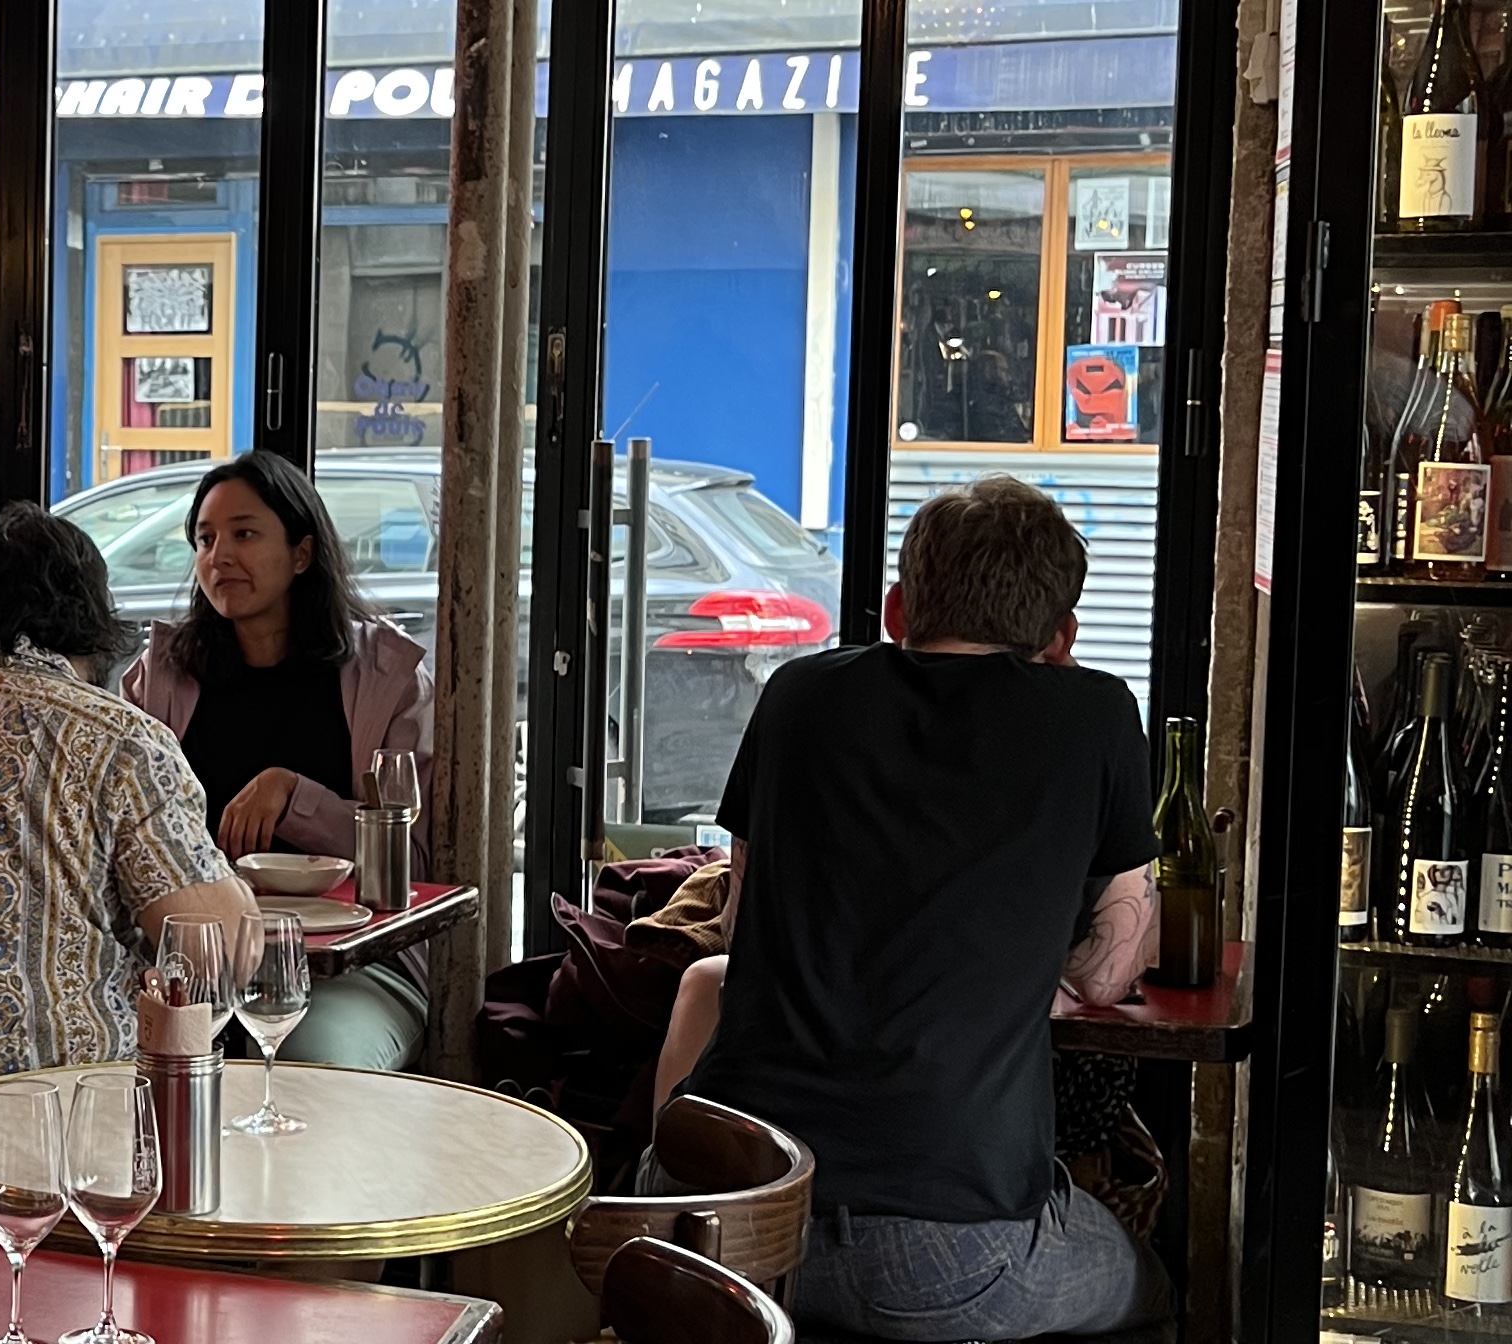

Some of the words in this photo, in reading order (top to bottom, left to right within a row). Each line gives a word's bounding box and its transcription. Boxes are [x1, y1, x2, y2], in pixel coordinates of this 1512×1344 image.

[55, 75, 213, 116] HAIR
[223, 74, 264, 116] D
[612, 50, 932, 113] MAGAZIE
